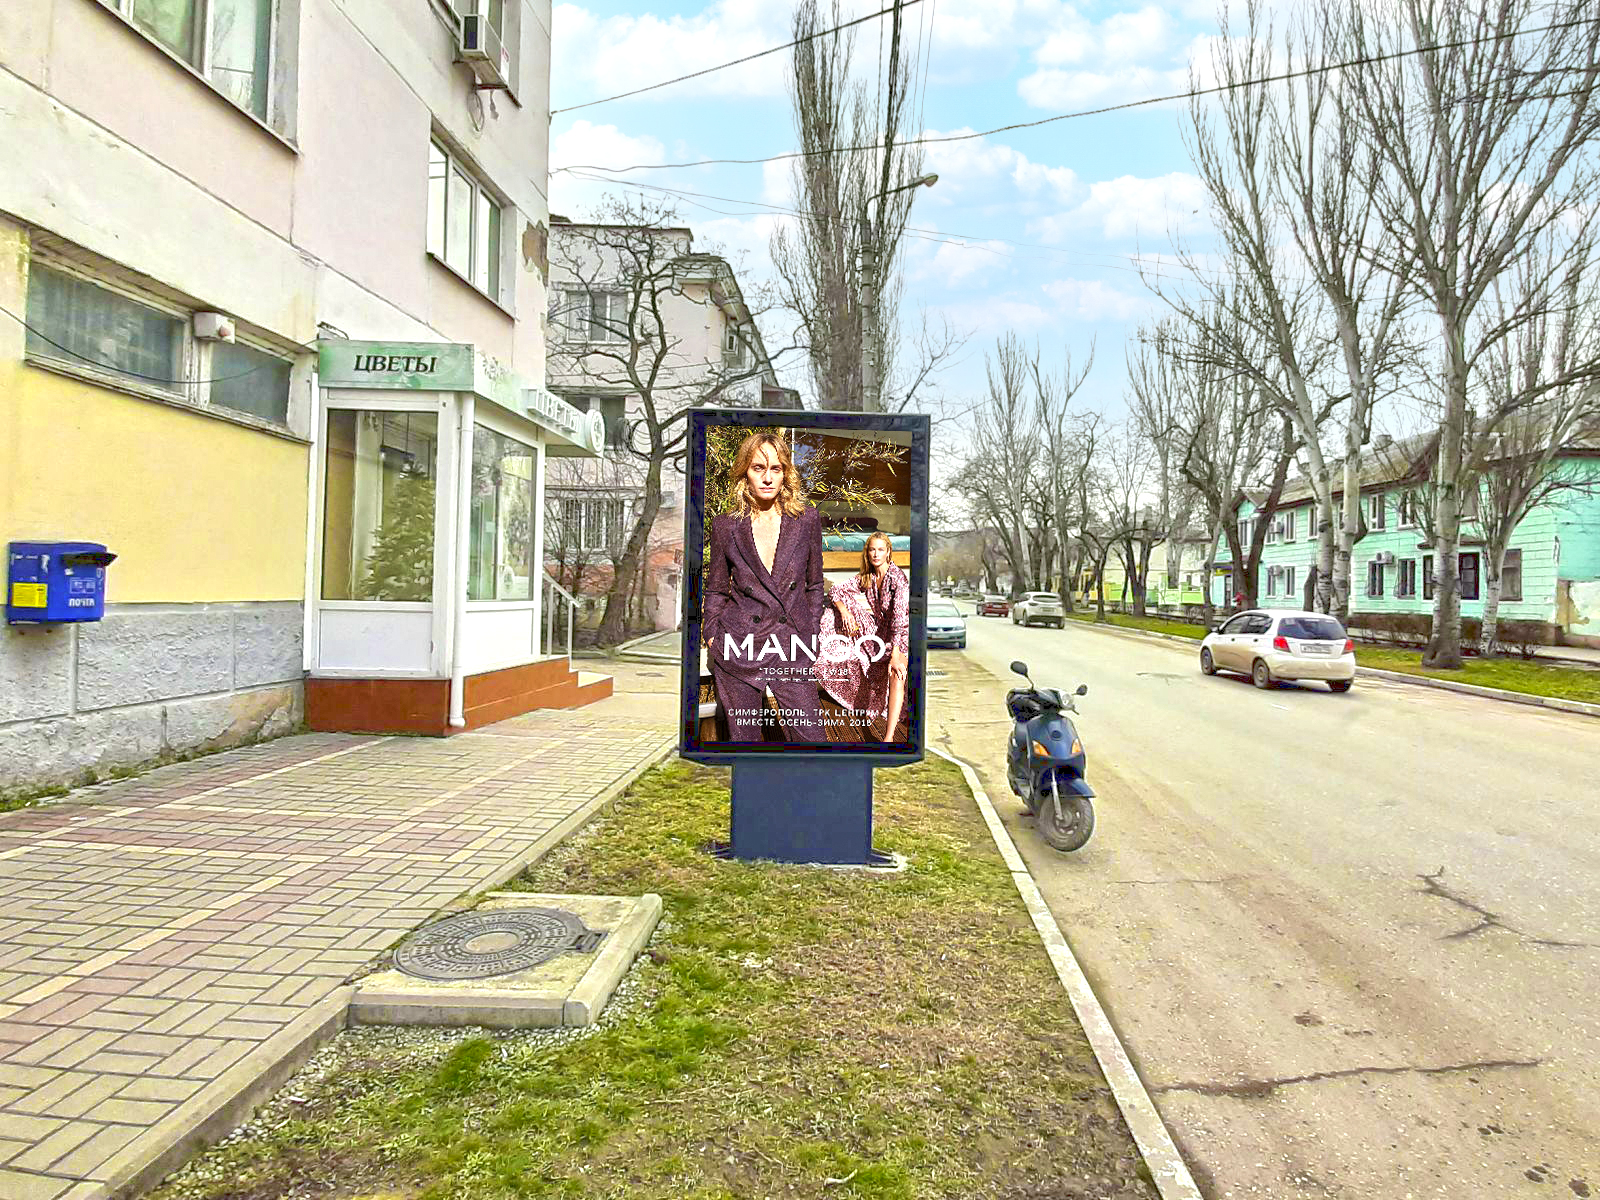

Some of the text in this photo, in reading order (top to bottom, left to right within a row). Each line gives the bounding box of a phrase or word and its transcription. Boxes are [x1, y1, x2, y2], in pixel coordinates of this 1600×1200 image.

[354, 354, 437, 373] ЦВЕТЫ
[68, 597, 95, 607] ПОЧТА
[723, 633, 887, 663] MANGO
[813, 708, 831, 717] ТРК
